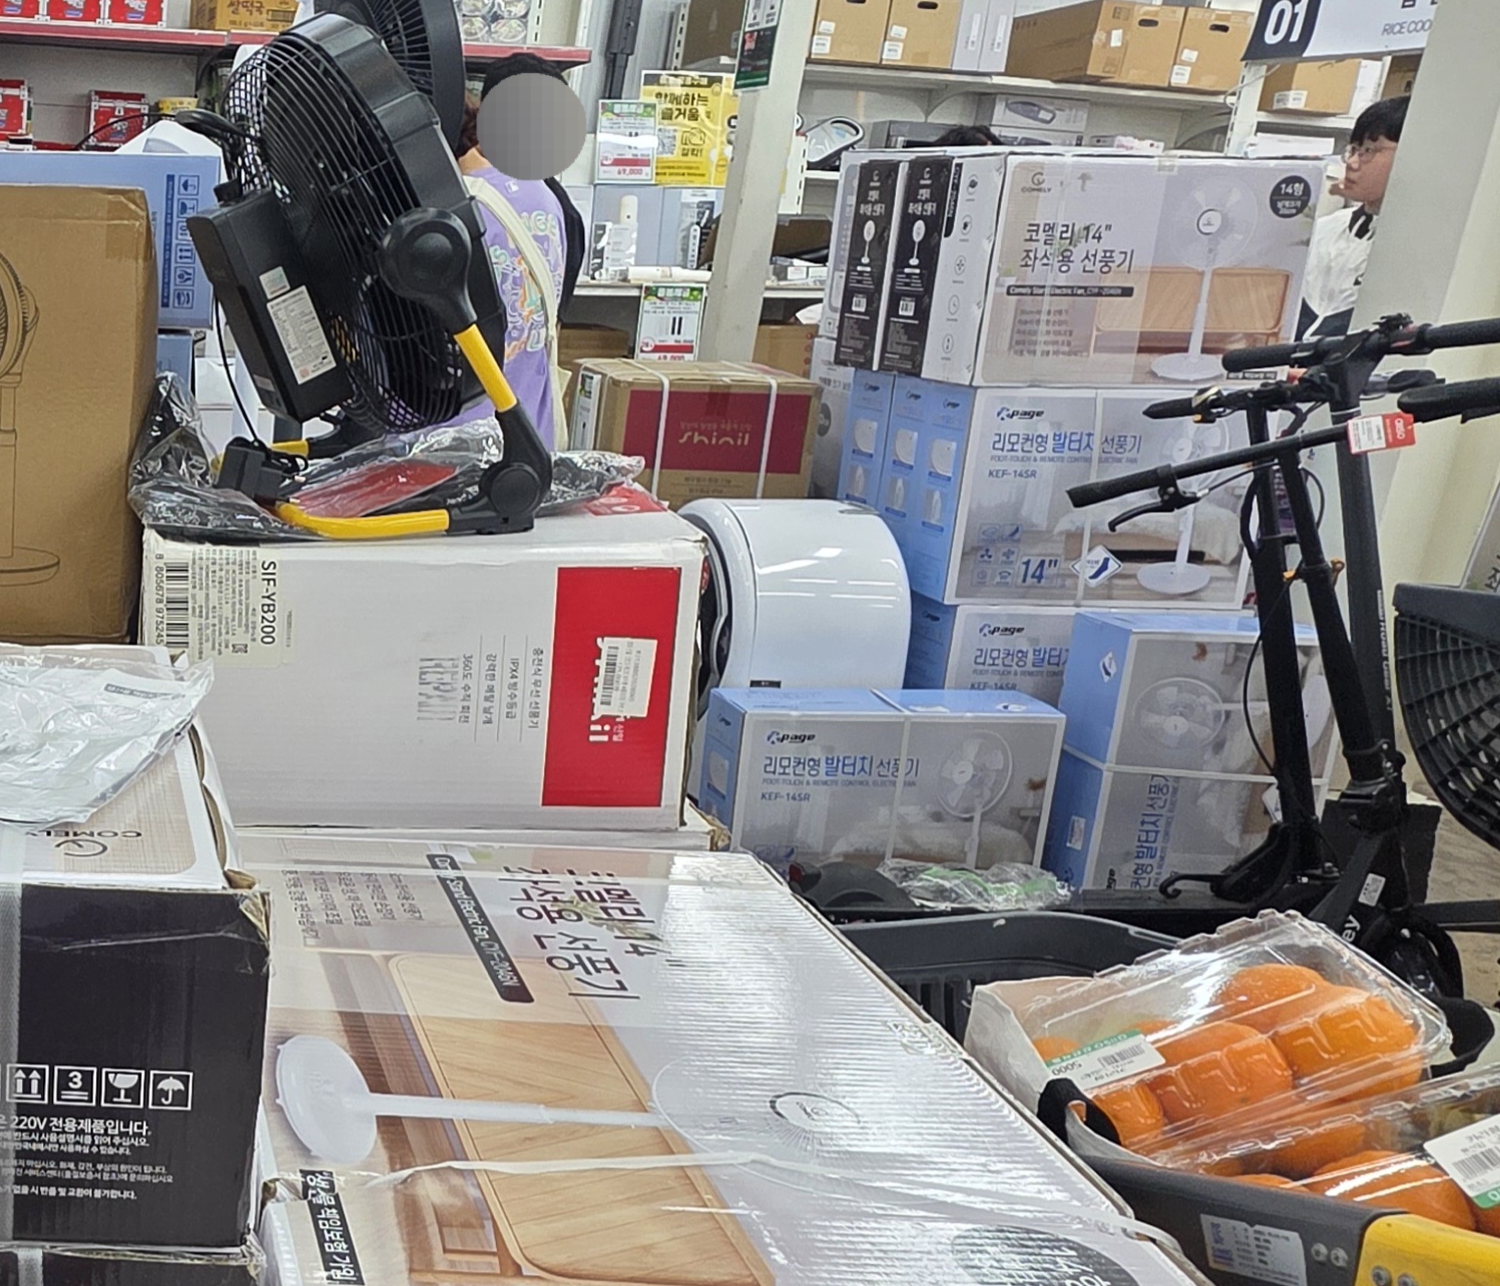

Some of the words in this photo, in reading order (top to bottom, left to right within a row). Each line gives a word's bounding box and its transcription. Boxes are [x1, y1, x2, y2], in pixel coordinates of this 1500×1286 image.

[1021, 186, 1052, 194] COMELY
[1279, 181, 1305, 196] 14형
[1024, 221, 1077, 246] 코멜리
[1019, 247, 1075, 274] 좌석용
[1080, 248, 1135, 274] 선풍기
[991, 433, 1049, 454] 리모컨형
[1101, 434, 1142, 455] 선풍기
[988, 469, 1037, 480] KEF-14SR
[1020, 558, 1058, 584] 14"
[260, 560, 277, 645] SIF-YB200
[973, 647, 1030, 668] 리모컨형
[763, 756, 822, 778] 리모컨형
[824, 755, 874, 777] 발터치
[760, 792, 812, 803] KEF-14SR
[1133, 813, 1164, 860] 발터치
[530, 931, 642, 1000] 선풍기
[9, 1116, 47, 1131] 220V
[49, 1116, 151, 1135] 전용제품입니다.
